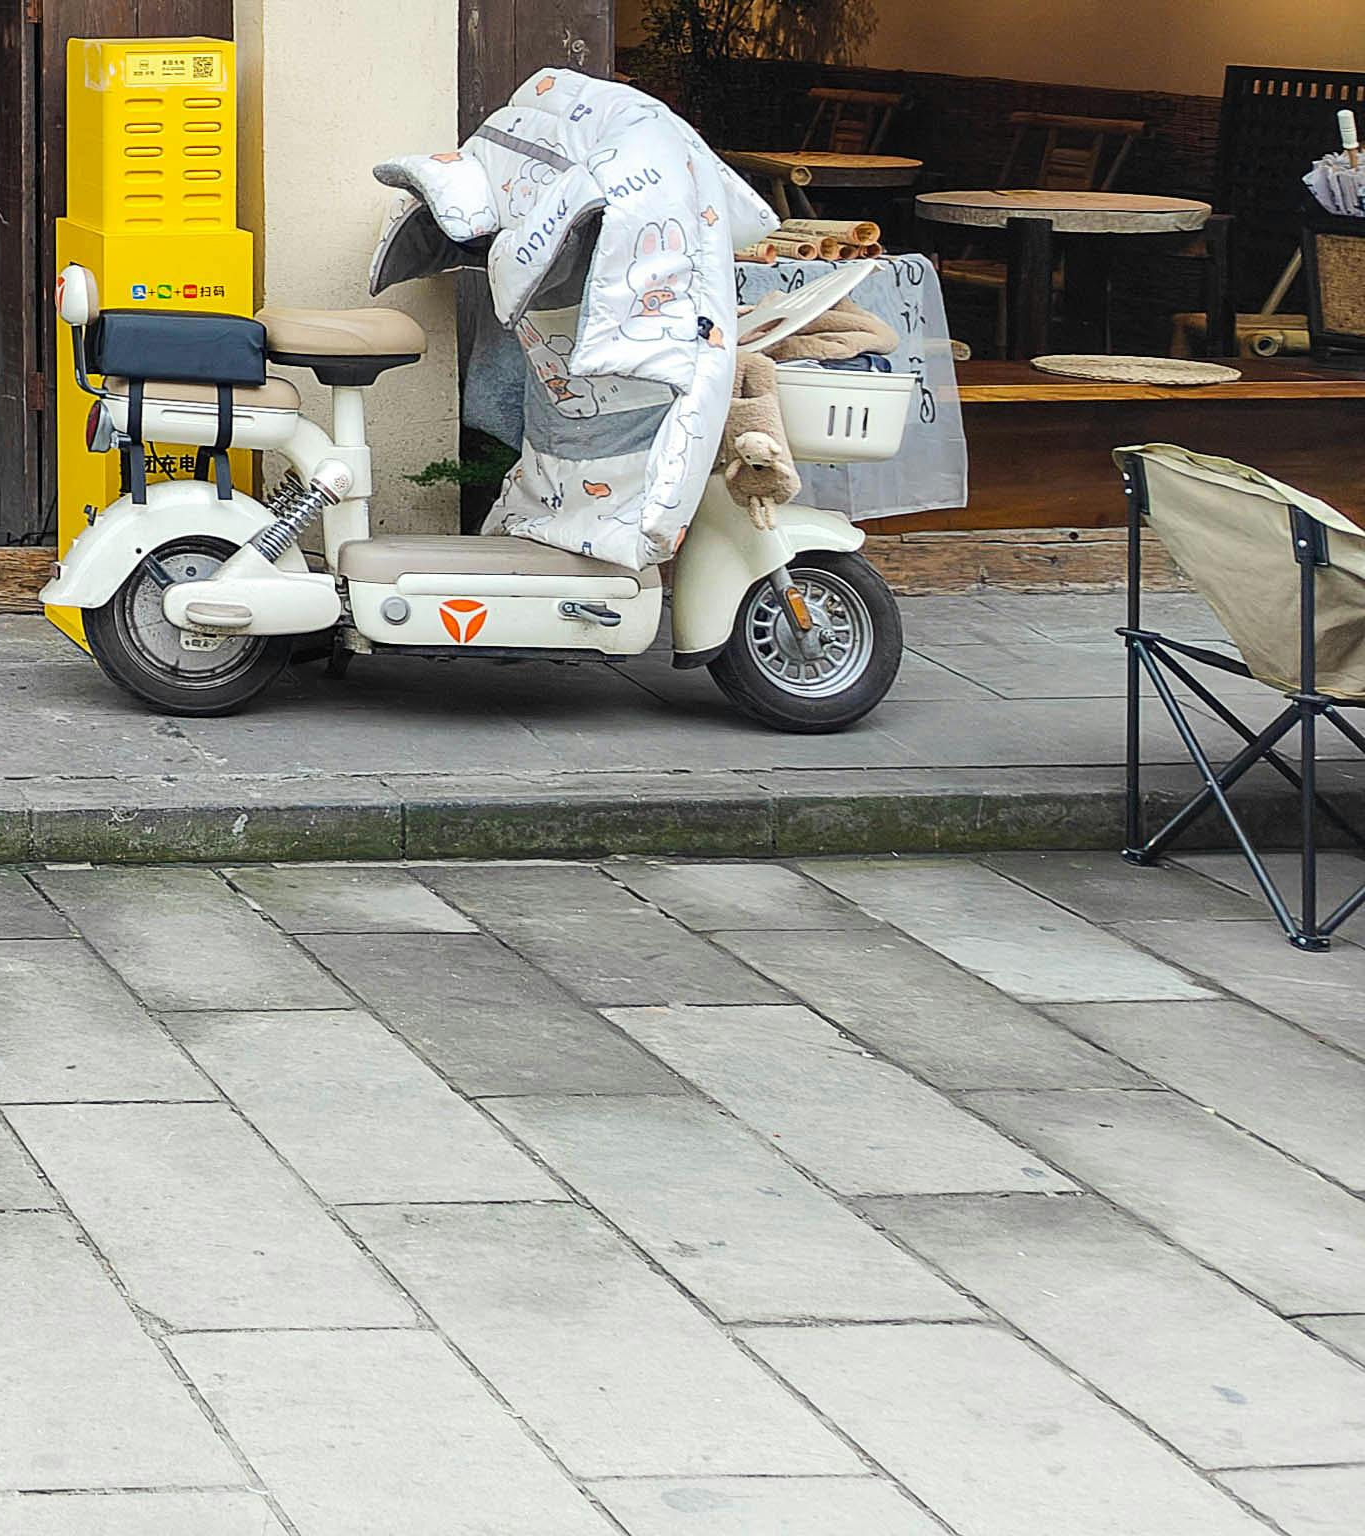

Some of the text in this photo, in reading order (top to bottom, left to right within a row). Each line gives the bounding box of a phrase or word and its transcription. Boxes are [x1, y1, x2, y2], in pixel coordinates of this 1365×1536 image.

[199, 285, 225, 298] 扫码
[142, 453, 197, 474] 团充电
